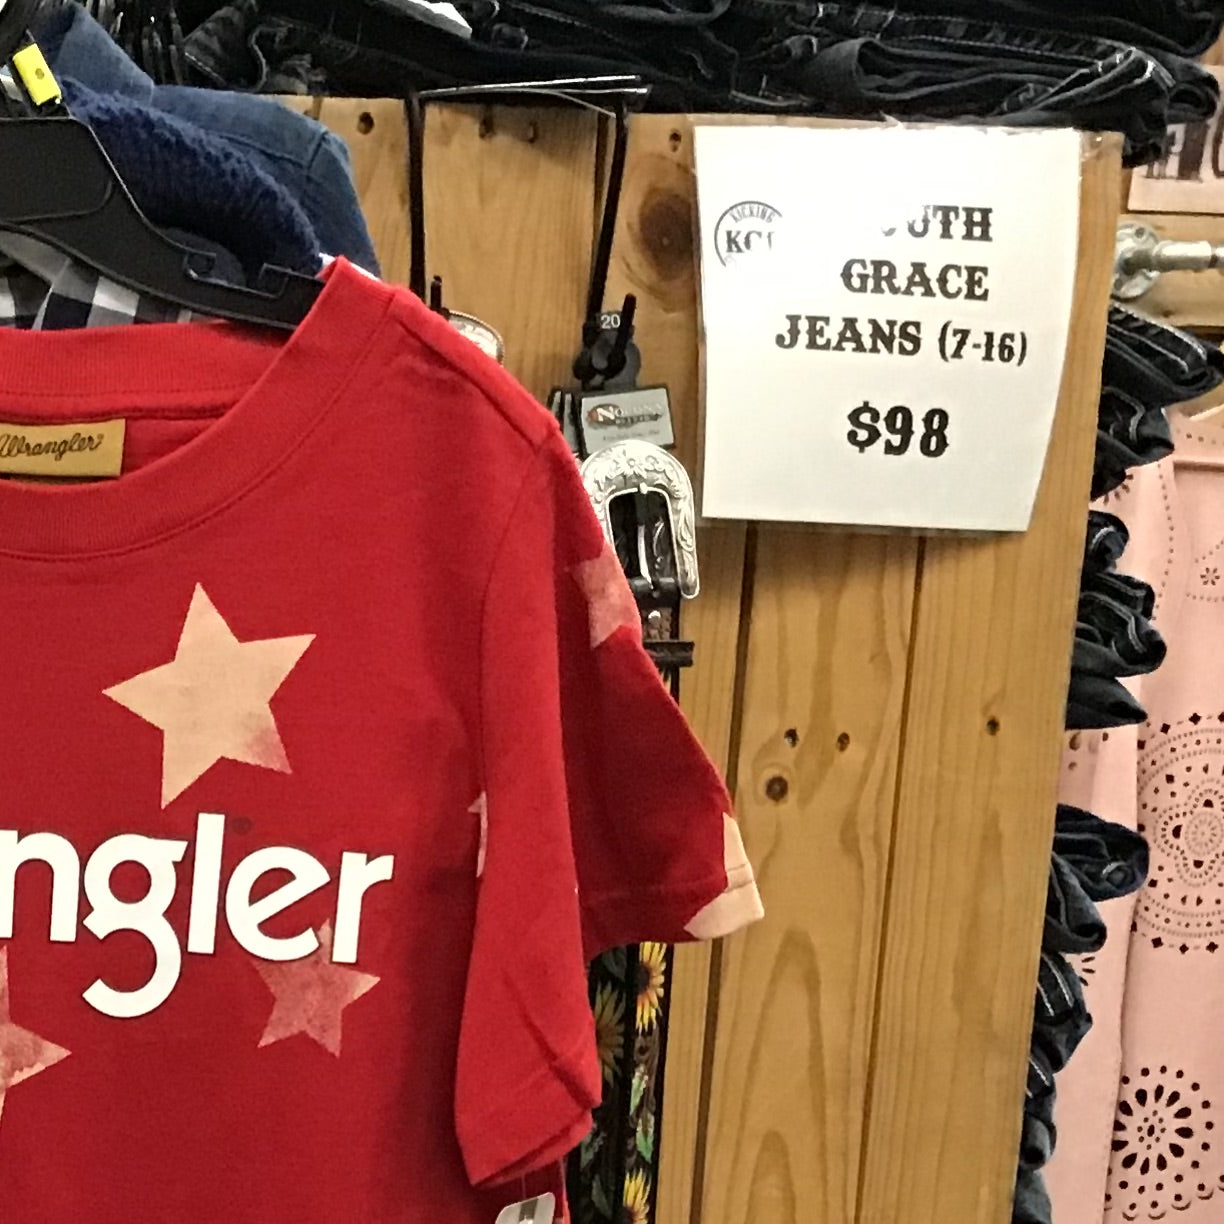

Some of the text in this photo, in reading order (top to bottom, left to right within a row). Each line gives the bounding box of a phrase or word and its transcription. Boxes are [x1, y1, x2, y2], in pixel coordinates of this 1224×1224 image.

[839, 258, 990, 302] GRACE
[600, 314, 621, 330] 20
[775, 314, 1027, 367] JEANS (7-16)
[846, 401, 950, 458] $98
